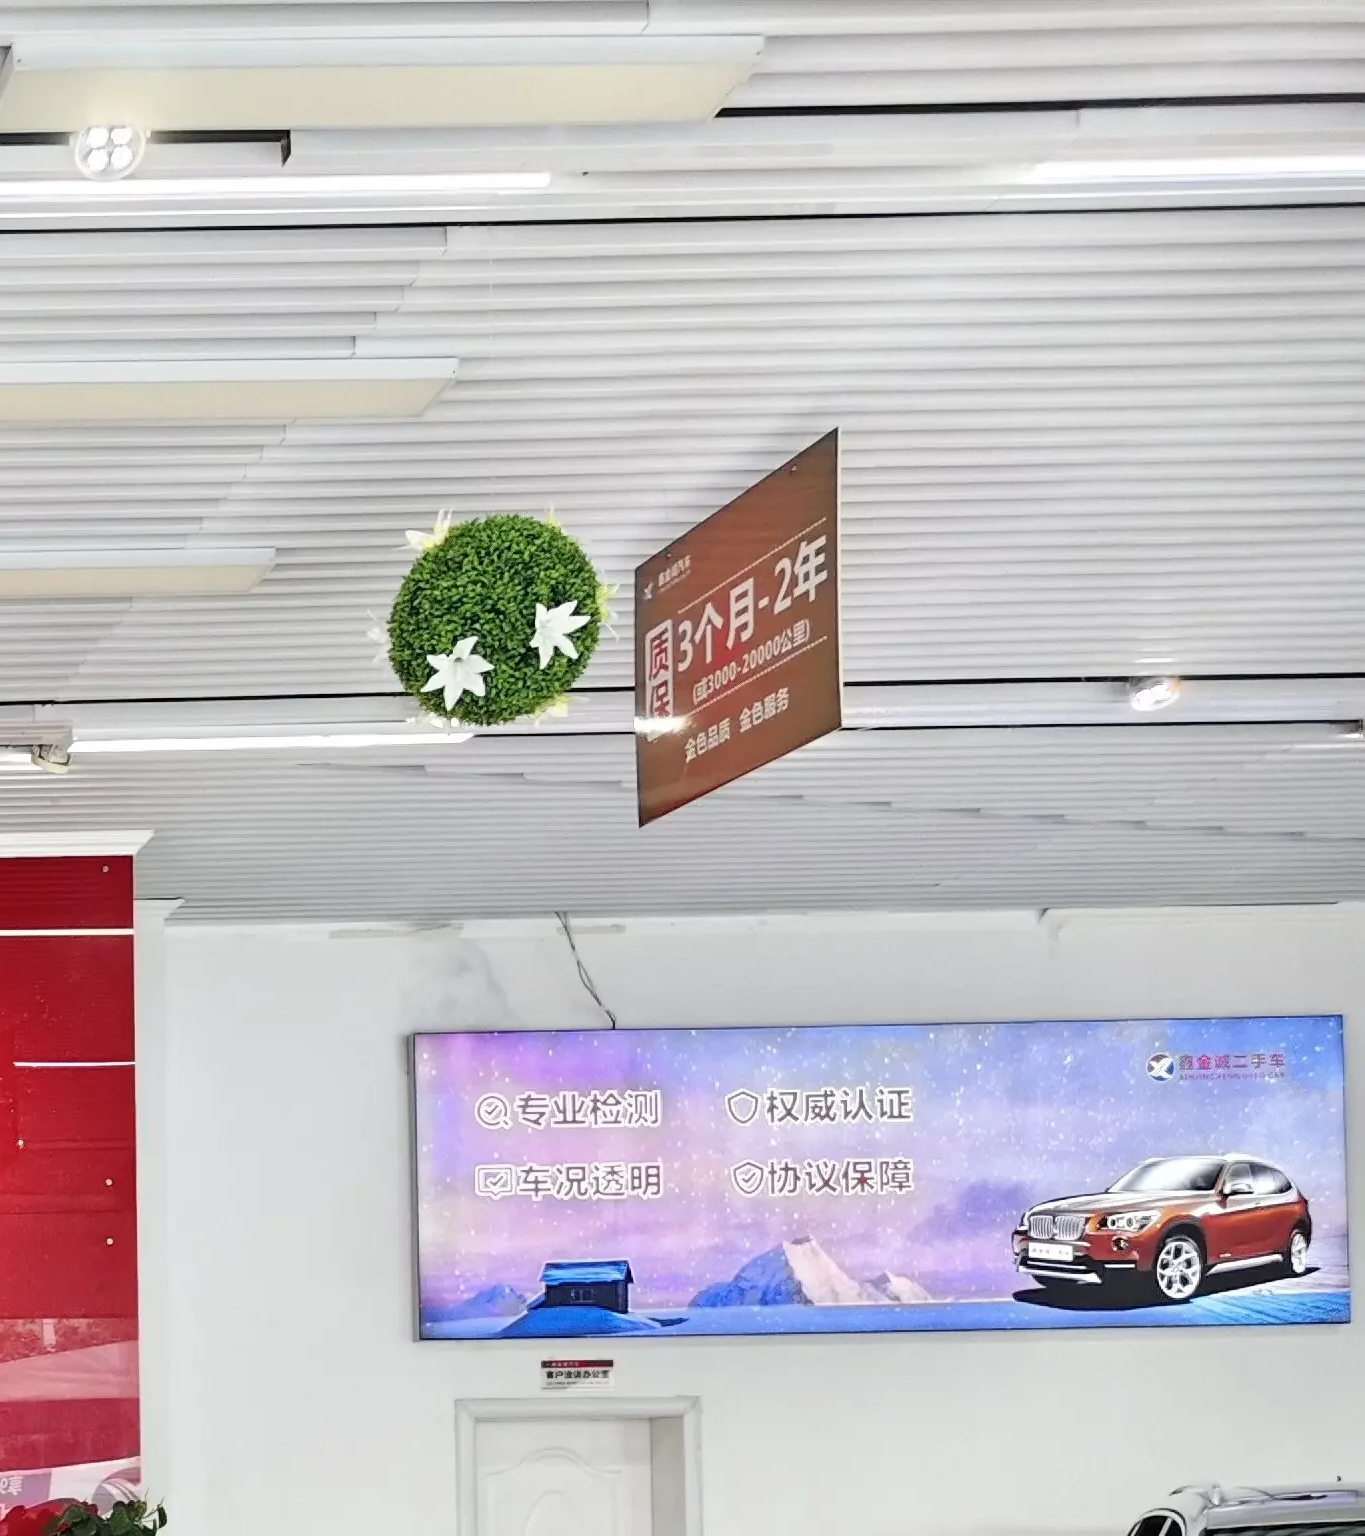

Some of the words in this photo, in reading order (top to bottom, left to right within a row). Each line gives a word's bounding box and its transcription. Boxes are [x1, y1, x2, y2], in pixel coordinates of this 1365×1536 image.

[677, 534, 828, 673] 3个月-2年
[684, 717, 731, 763] 金色品质
[739, 687, 790, 733] 金色服务
[515, 1091, 662, 1128] 专业检测
[766, 1087, 913, 1123] 权威认证
[516, 1164, 662, 1200] 车况透明
[766, 1159, 913, 1195] 协议保障
